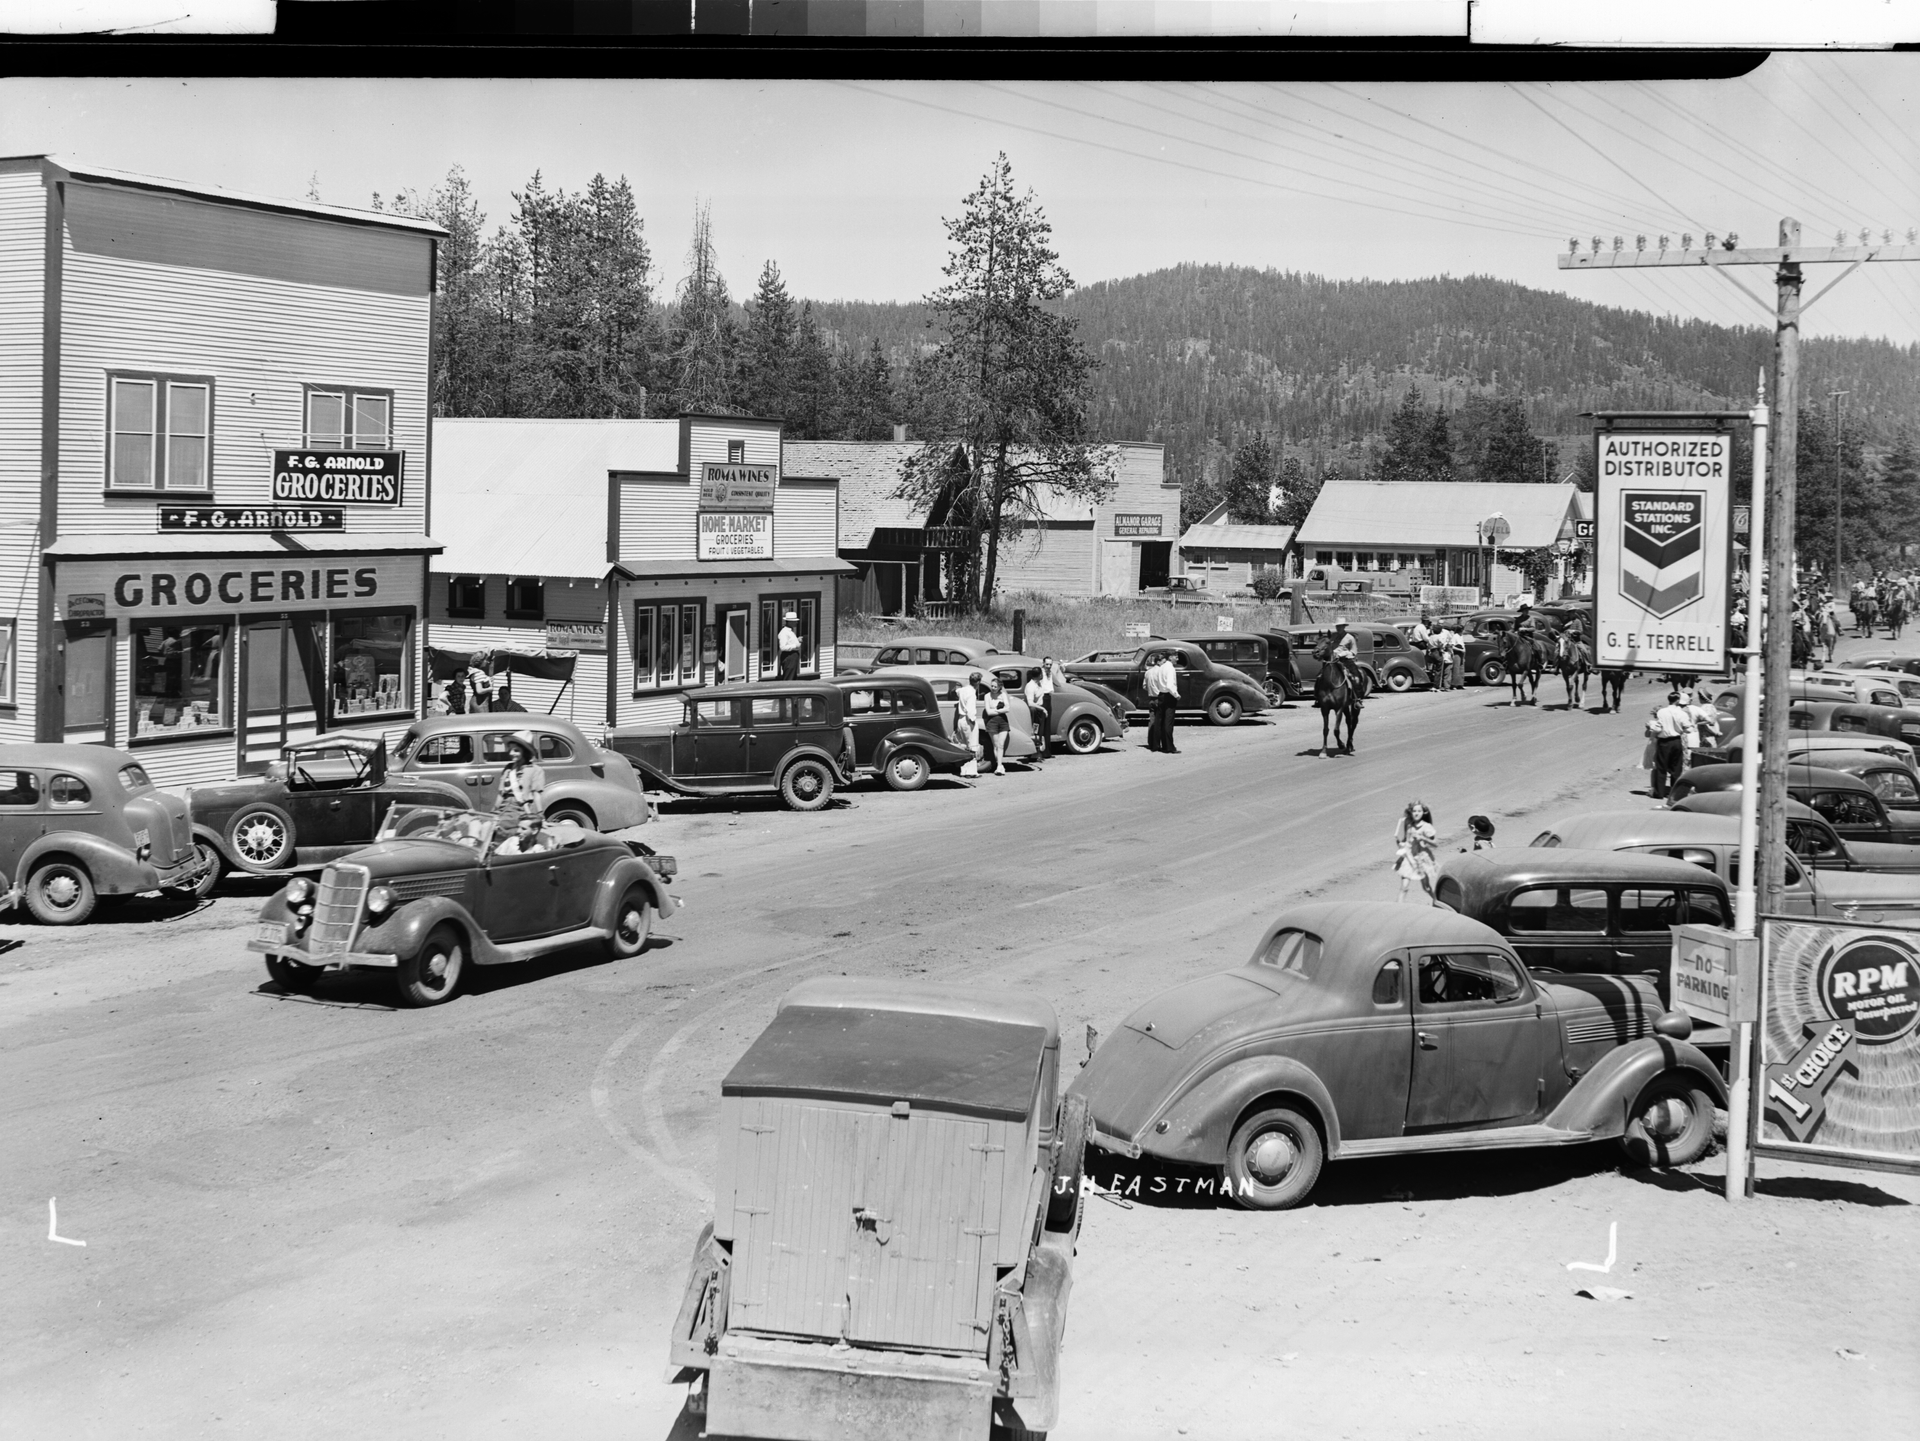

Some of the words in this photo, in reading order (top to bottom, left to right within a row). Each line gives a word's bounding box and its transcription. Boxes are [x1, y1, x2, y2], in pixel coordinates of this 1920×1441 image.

[1606, 441, 1723, 457] AUTHORIZED
[324, 456, 385, 470] ARNOLD
[1605, 460, 1723, 478] DISTRIBUTOR
[708, 468, 736, 482] ROMA
[739, 469, 770, 483] WINES
[275, 472, 395, 501] GROCERIES
[1631, 501, 1695, 511] STANDARD
[702, 515, 726, 533] HOME
[729, 515, 767, 532] MARKET
[1141, 516, 1161, 526] GARAGE
[1634, 513, 1691, 524] STATIONS
[1483, 525, 1511, 535] SHELL
[1651, 524, 1676, 534] INC.
[716, 534, 754, 545] GROCERIES
[709, 547, 725, 555] FRUIT
[731, 546, 764, 555] VEGETABLES
[114, 568, 378, 607] GROCERIES
[1427, 589, 1472, 601] GAGE
[575, 624, 604, 635] WINES
[1607, 632, 1621, 648] G.
[1627, 633, 1641, 649] E.
[1646, 633, 1715, 652] TERRELL
[1695, 954, 1712, 974] NO
[1676, 972, 1730, 1001] PARKING
[1833, 961, 1909, 999] RPM
[1847, 997, 1886, 1011] MOTOR
[1886, 993, 1907, 1004] OIL
[1855, 1001, 1918, 1021] Unsurpassed
[1795, 1023, 1853, 1087] CHOICE
